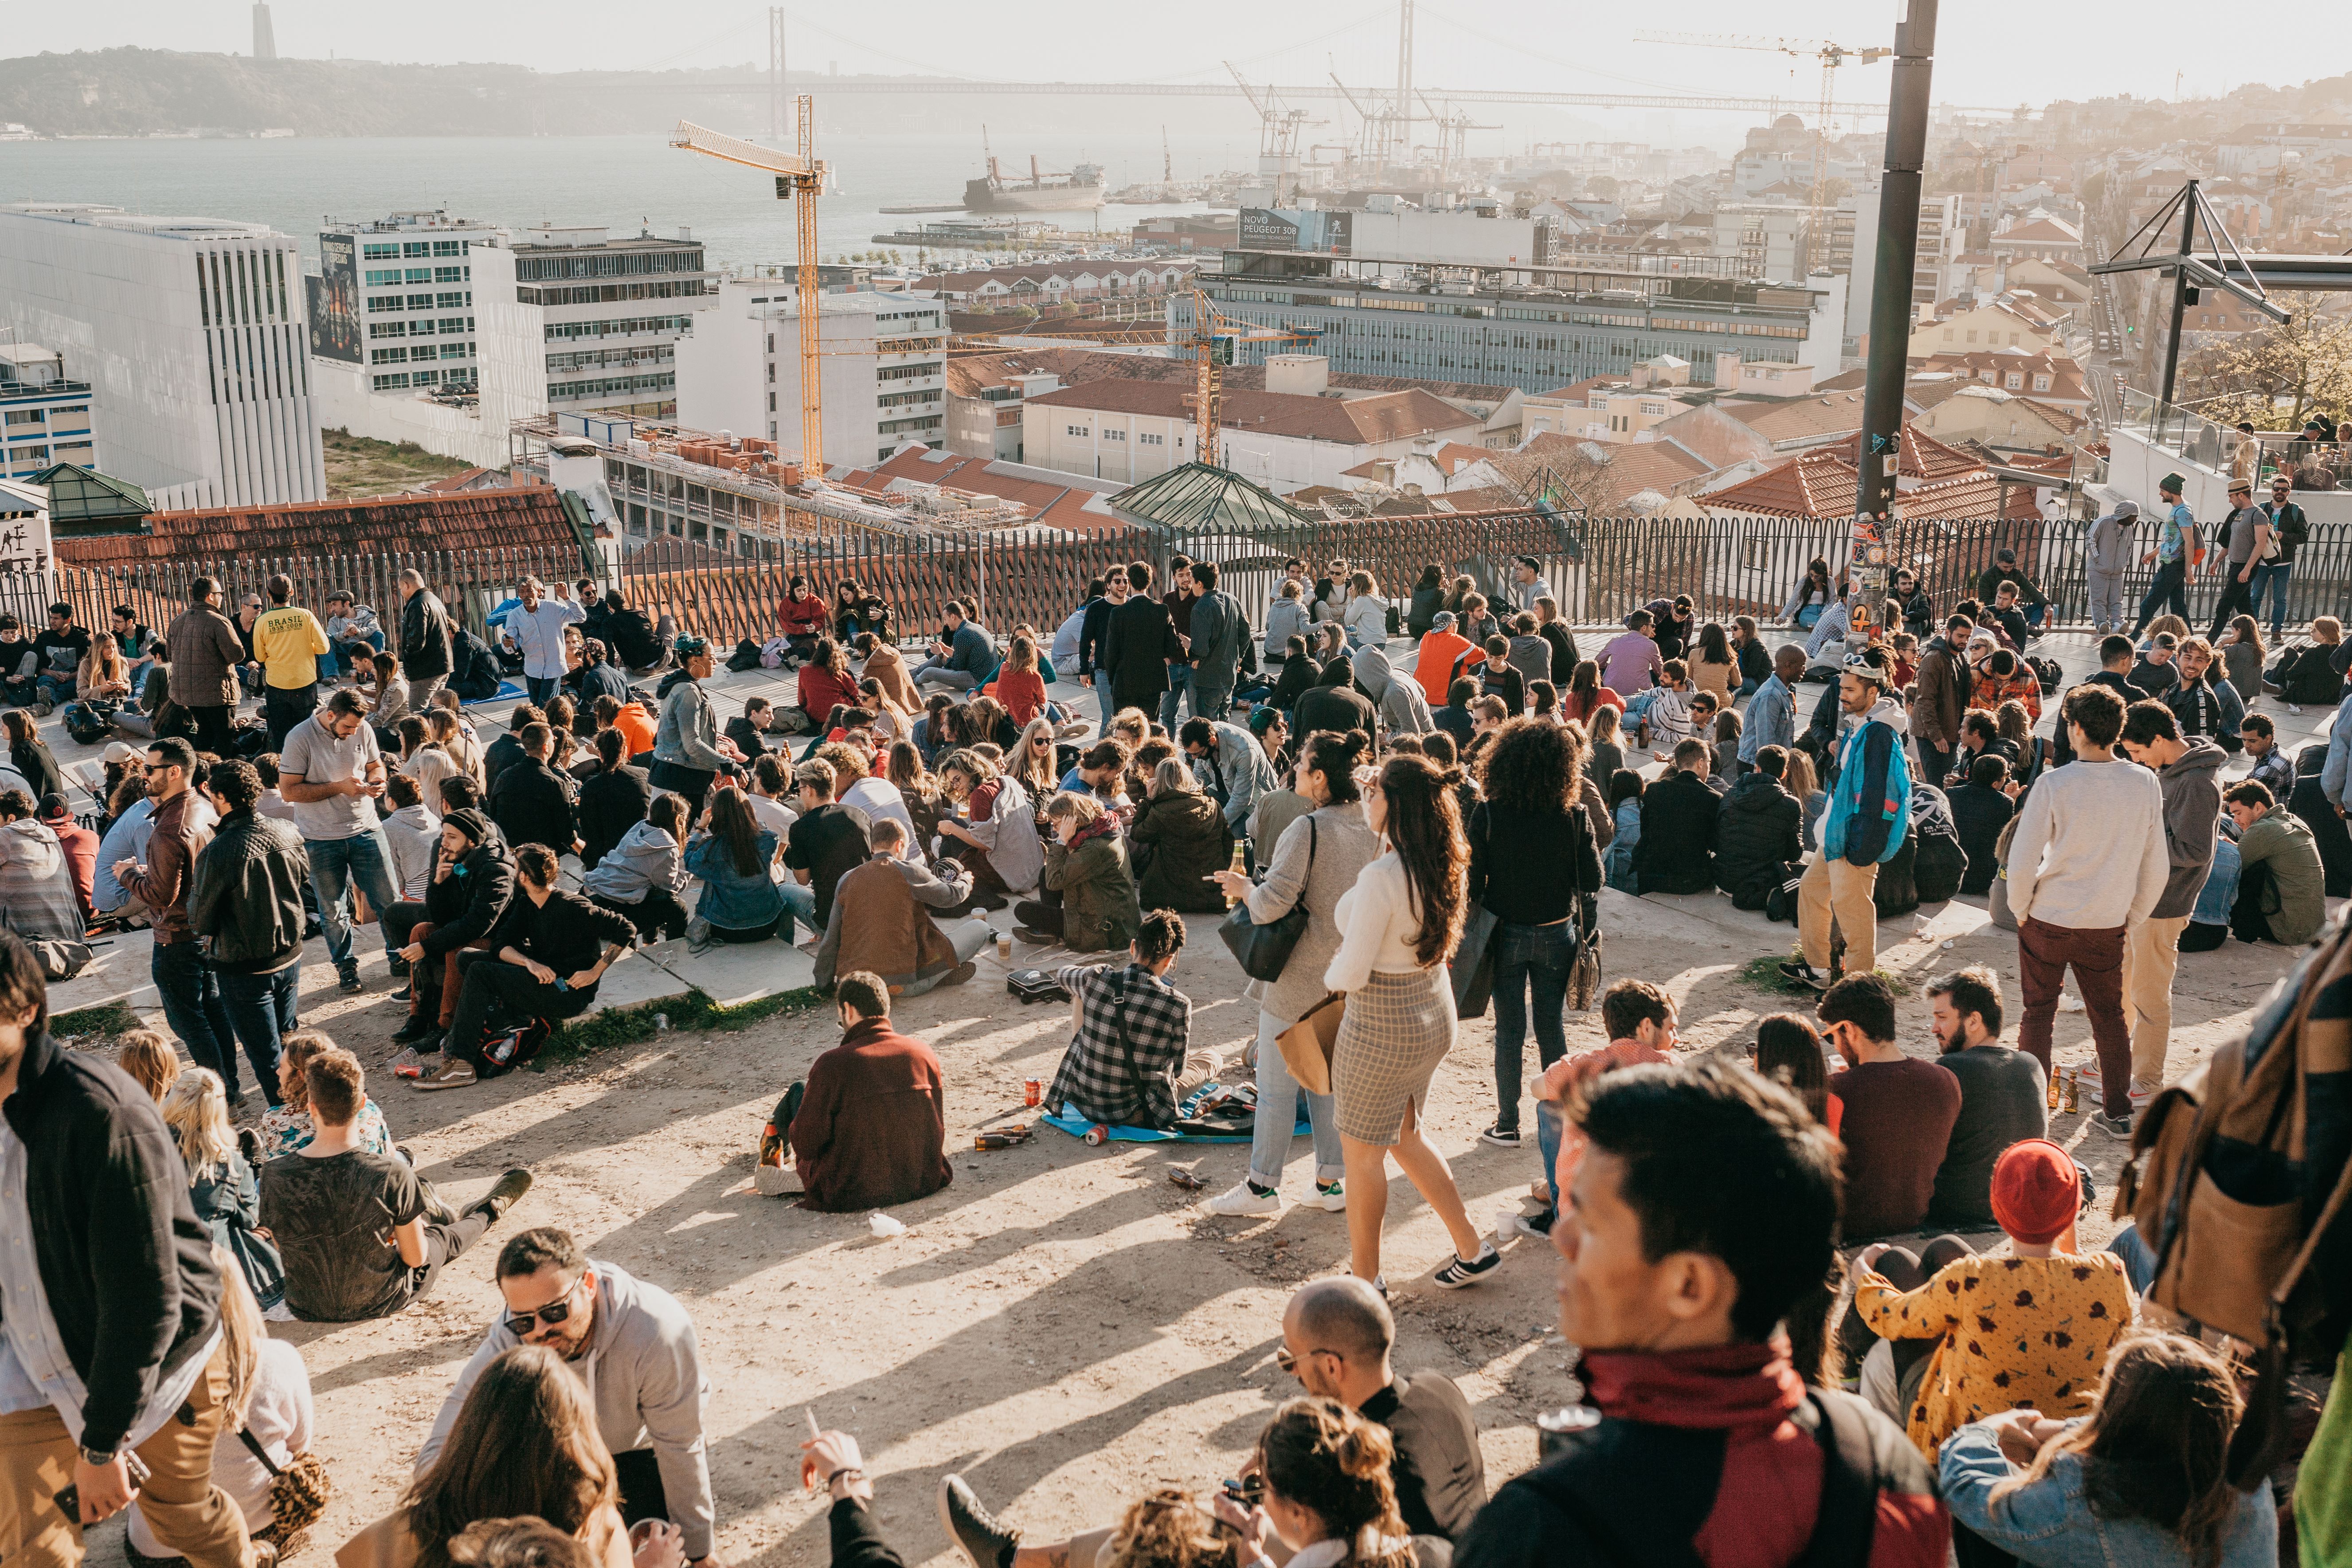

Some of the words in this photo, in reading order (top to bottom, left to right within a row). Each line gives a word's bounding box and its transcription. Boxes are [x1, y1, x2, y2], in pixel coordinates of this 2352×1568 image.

[1244, 225, 1280, 234] PEUGEOT
[1283, 226, 1296, 235] 308
[268, 615, 302, 627] BRASIL
[269, 622, 302, 632] 1958-2008
[1797, 969, 1808, 978] N
